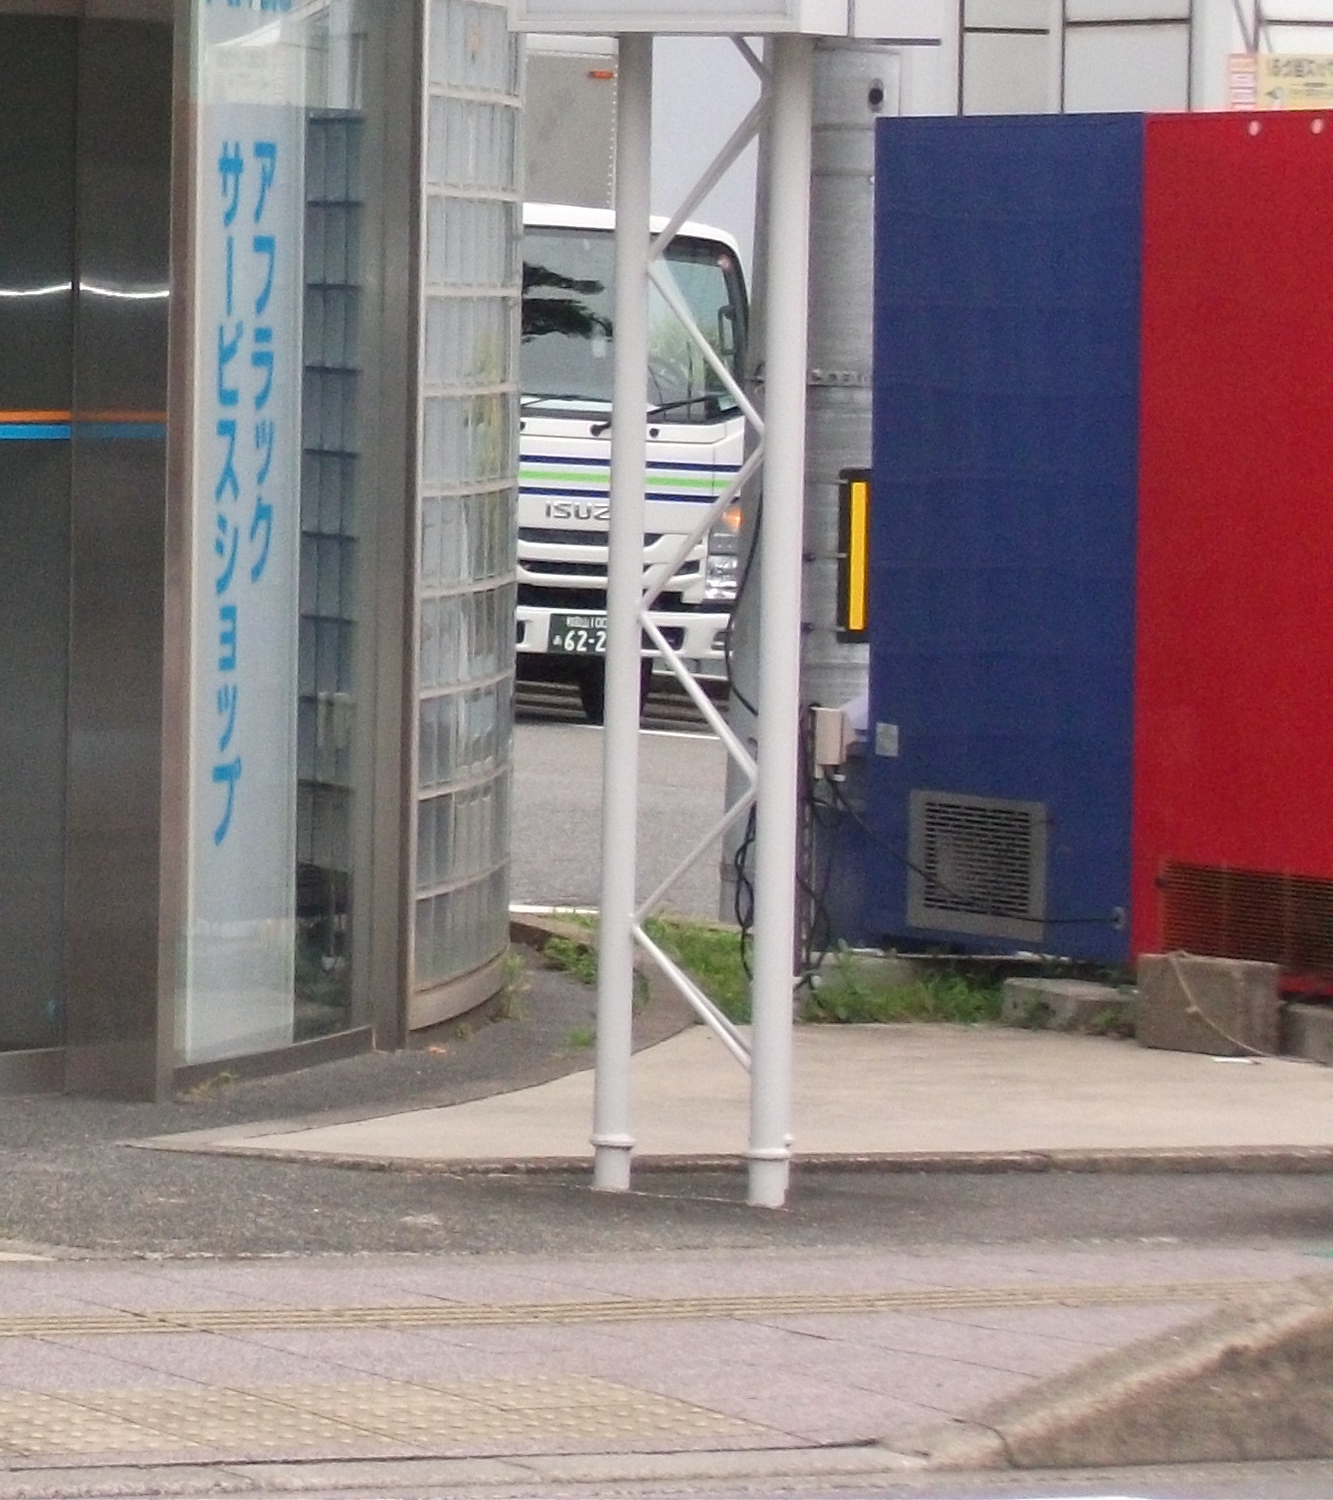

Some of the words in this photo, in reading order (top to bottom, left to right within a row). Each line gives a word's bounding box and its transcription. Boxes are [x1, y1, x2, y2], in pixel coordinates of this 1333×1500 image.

[250, 141, 278, 584] アフラック
[212, 141, 245, 846] サービスショップ
[545, 500, 610, 520] ISUZ
[564, 630, 607, 652] 62-2
